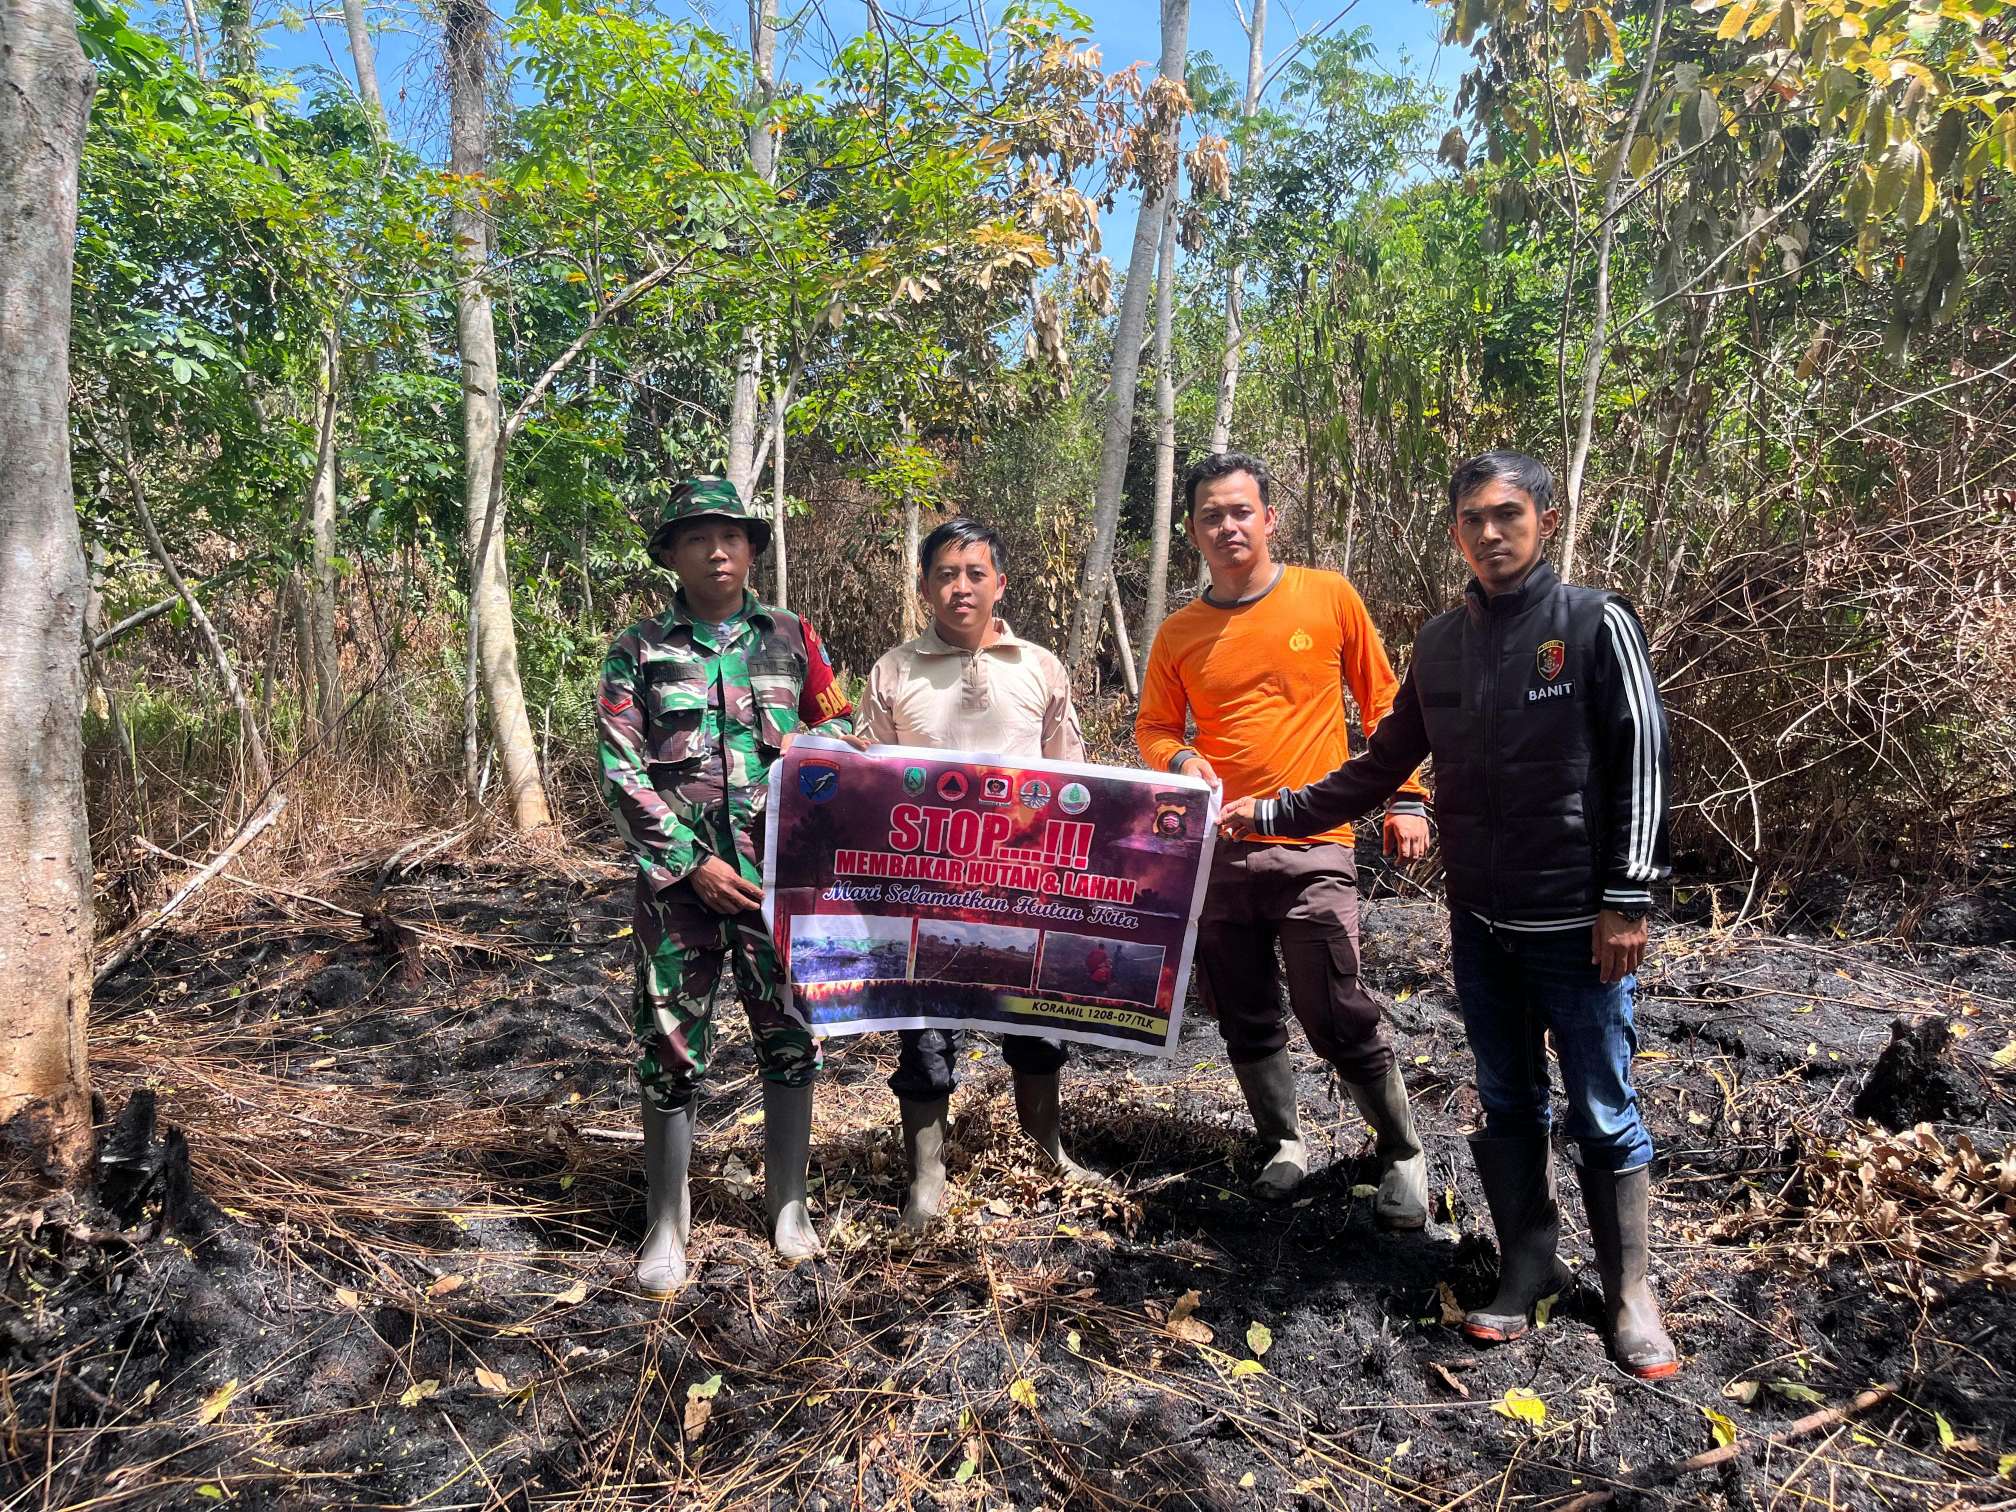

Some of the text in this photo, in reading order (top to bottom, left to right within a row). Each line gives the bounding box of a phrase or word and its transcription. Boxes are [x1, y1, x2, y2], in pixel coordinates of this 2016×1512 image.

[1528, 682, 1573, 701] BANIT
[834, 849, 1136, 905] MEMBAKAR HUTAN & LAHAN
[823, 880, 1139, 930] Mari Selamatkan Hutan Kita
[1032, 1001, 1153, 1029] KORAMIL 1208-07/TLK
